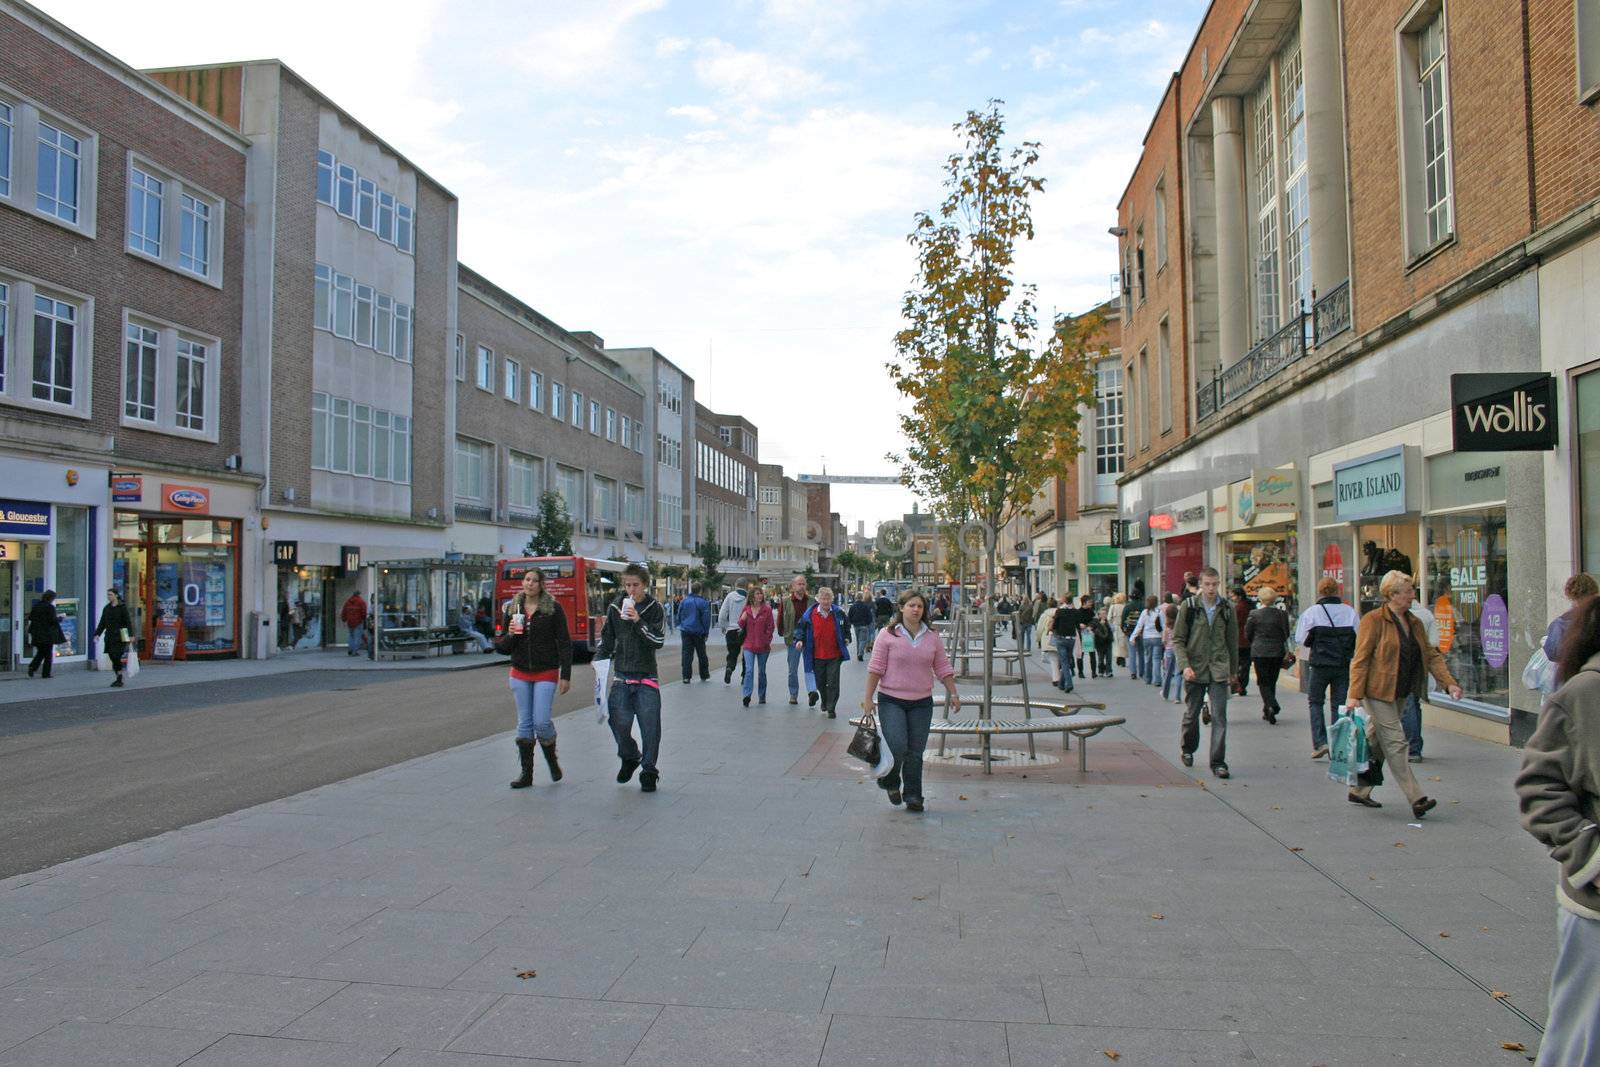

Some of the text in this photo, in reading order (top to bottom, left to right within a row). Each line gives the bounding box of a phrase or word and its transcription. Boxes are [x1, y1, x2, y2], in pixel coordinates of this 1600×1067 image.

[1464, 391, 1546, 433] wallis
[1339, 472, 1401, 503] RIVER ISLAND
[7, 510, 48, 523] Gloucester
[276, 545, 293, 559] GAP
[1450, 565, 1487, 587] SALE
[1460, 592, 1478, 603] MEN
[1484, 629, 1505, 639] PRICE
[1485, 641, 1504, 651] SALE
